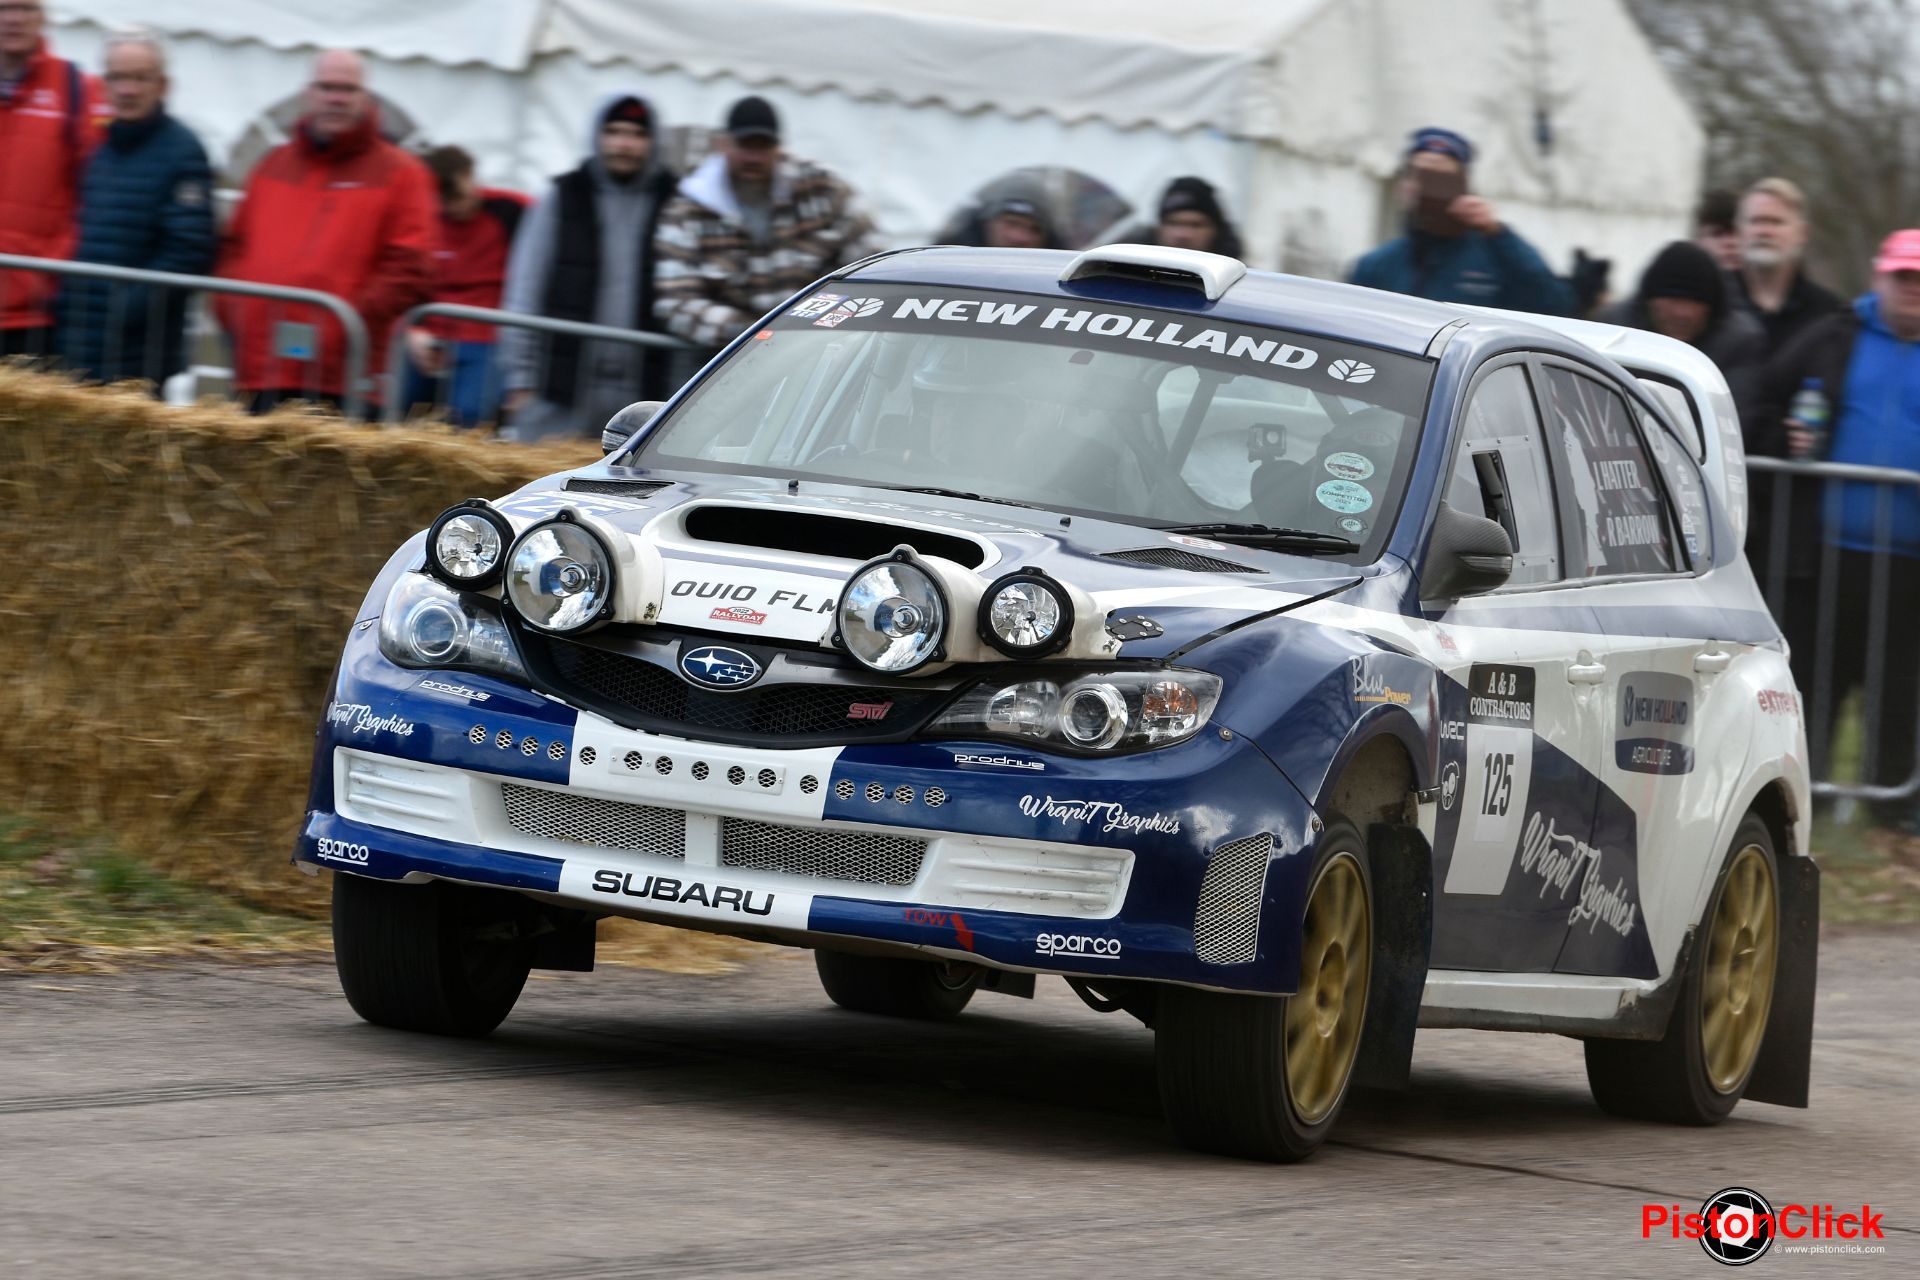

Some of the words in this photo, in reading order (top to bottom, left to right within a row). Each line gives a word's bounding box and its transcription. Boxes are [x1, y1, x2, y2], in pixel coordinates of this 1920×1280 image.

[892, 298, 1038, 325] NEW
[1040, 308, 1318, 370] HOLLAND
[1600, 460, 1641, 491] HATTER
[712, 609, 764, 621] RALLYDAY
[1349, 656, 1384, 694] Blue
[1488, 672, 1496, 694] A
[1497, 673, 1506, 694] &
[1507, 674, 1516, 696] B
[419, 680, 491, 701] prodrive
[1384, 686, 1411, 704] Power
[353, 705, 414, 736] Graphics
[1470, 697, 1531, 720] CONTRACTORS
[1635, 697, 1653, 722] NEW
[955, 754, 1045, 770] prodrive
[1482, 753, 1514, 816] 125
[1103, 803, 1180, 835] Graphics
[317, 837, 369, 864] sparco
[592, 869, 775, 916] SUBARU
[1568, 849, 1635, 937] Graphics
[904, 909, 947, 927] TOW
[1036, 933, 1121, 958] sparco
